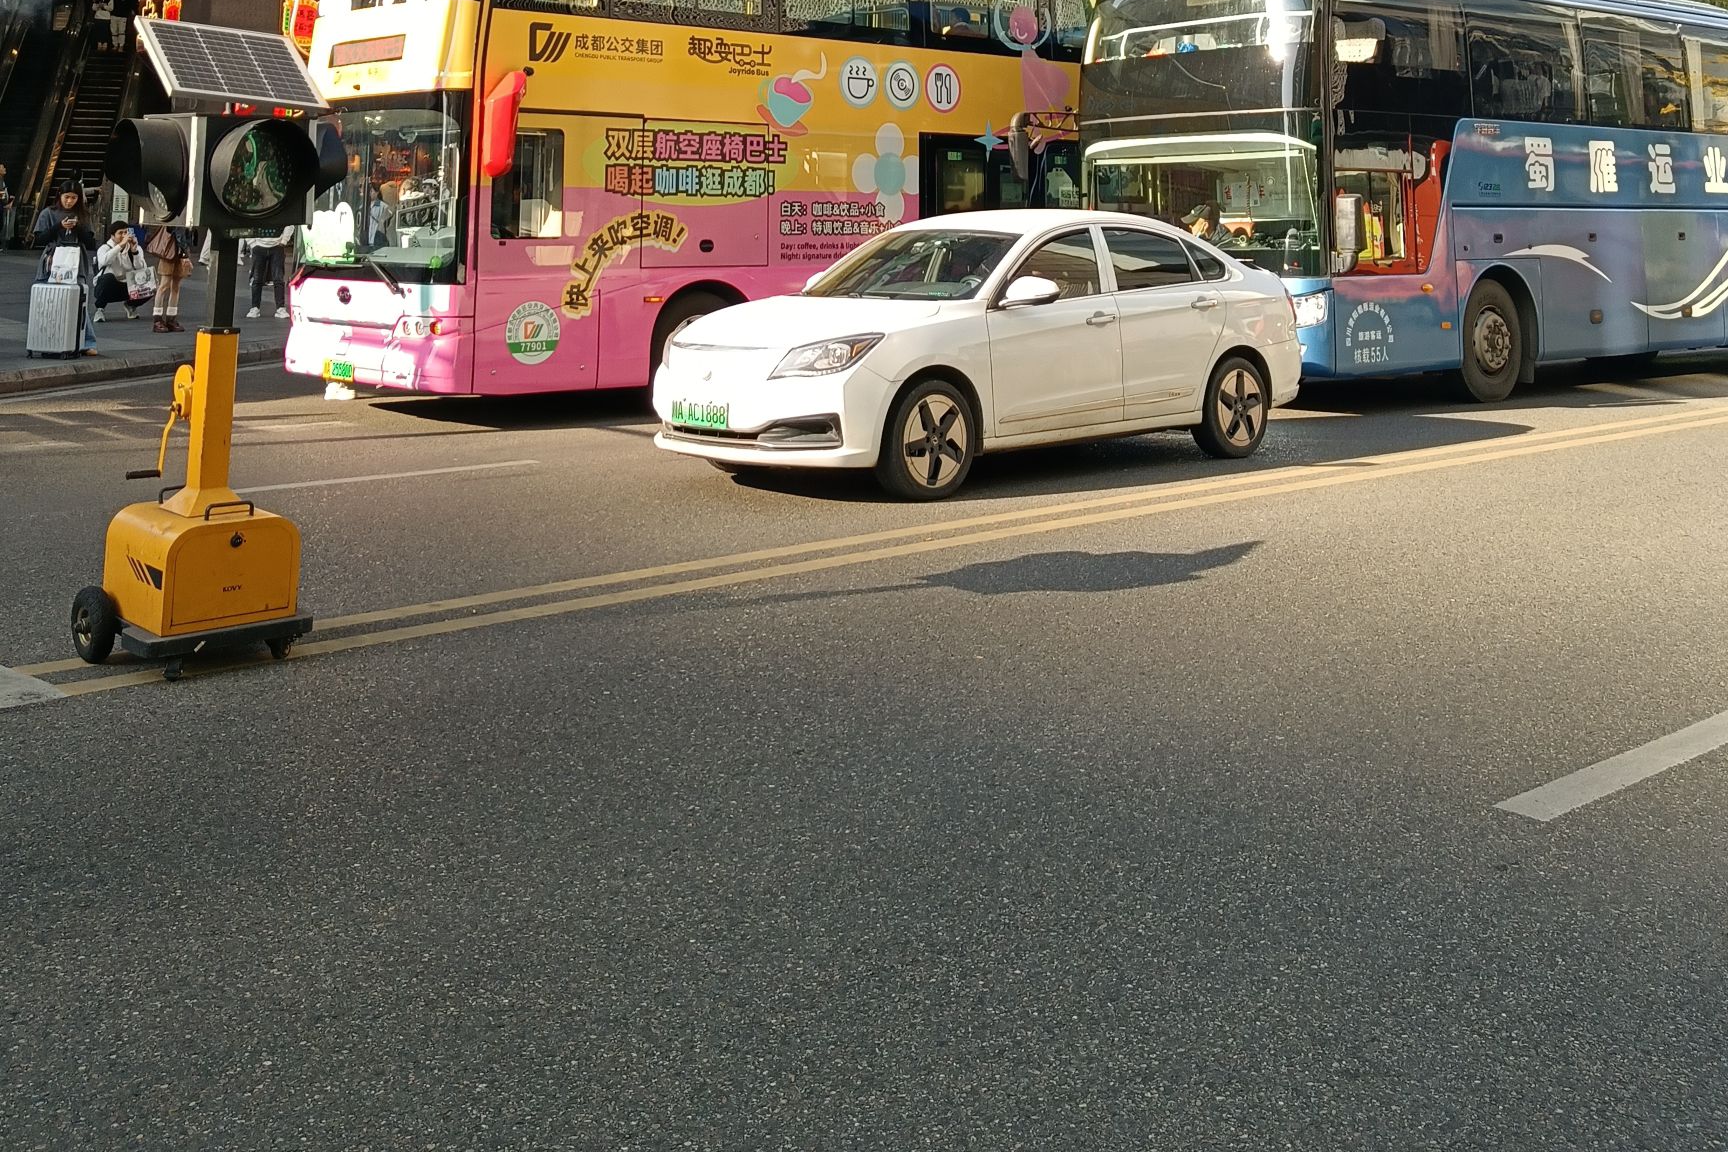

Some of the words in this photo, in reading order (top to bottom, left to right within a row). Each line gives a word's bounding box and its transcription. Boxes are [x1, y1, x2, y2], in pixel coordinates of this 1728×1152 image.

[574, 33, 664, 56] 成都公交集团
[728, 66, 755, 77] Joyride
[756, 69, 770, 77] Bus
[604, 128, 789, 164] 双层航空座椅巴士
[802, 252, 832, 261] signature
[520, 341, 547, 353] 77901
[1354, 346, 1389, 364] 核载55人
